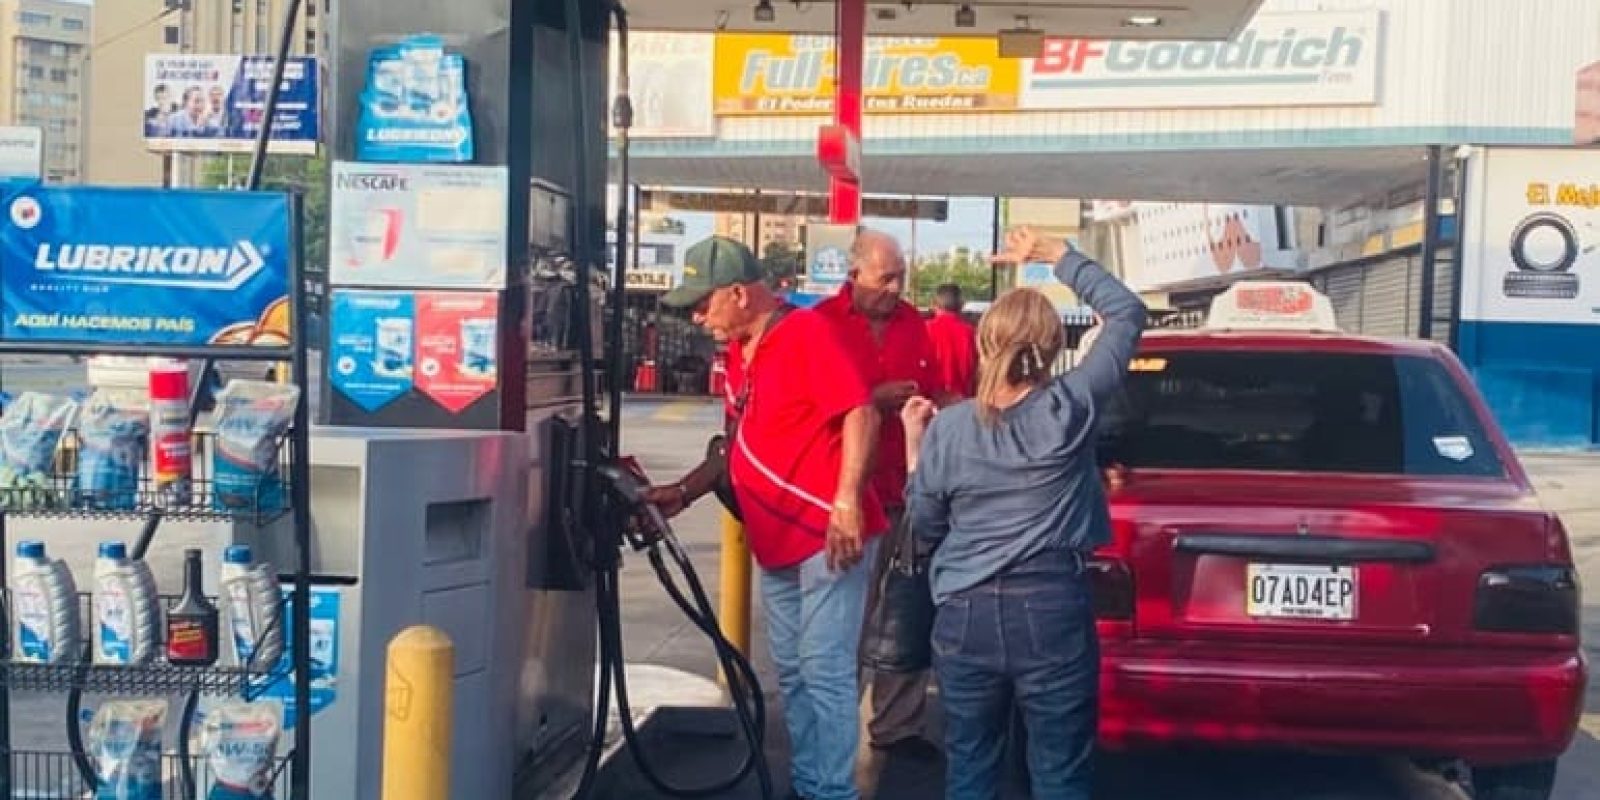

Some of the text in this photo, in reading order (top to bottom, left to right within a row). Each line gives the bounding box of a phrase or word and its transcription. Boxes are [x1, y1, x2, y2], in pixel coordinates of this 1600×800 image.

[1033, 26, 1362, 74] BFGoodrich
[739, 50, 958, 92] Full-ires
[35, 243, 231, 275] LUBRIKON
[61, 315, 151, 332] HACEMOS
[1252, 575, 1352, 607] 07AD4EP
